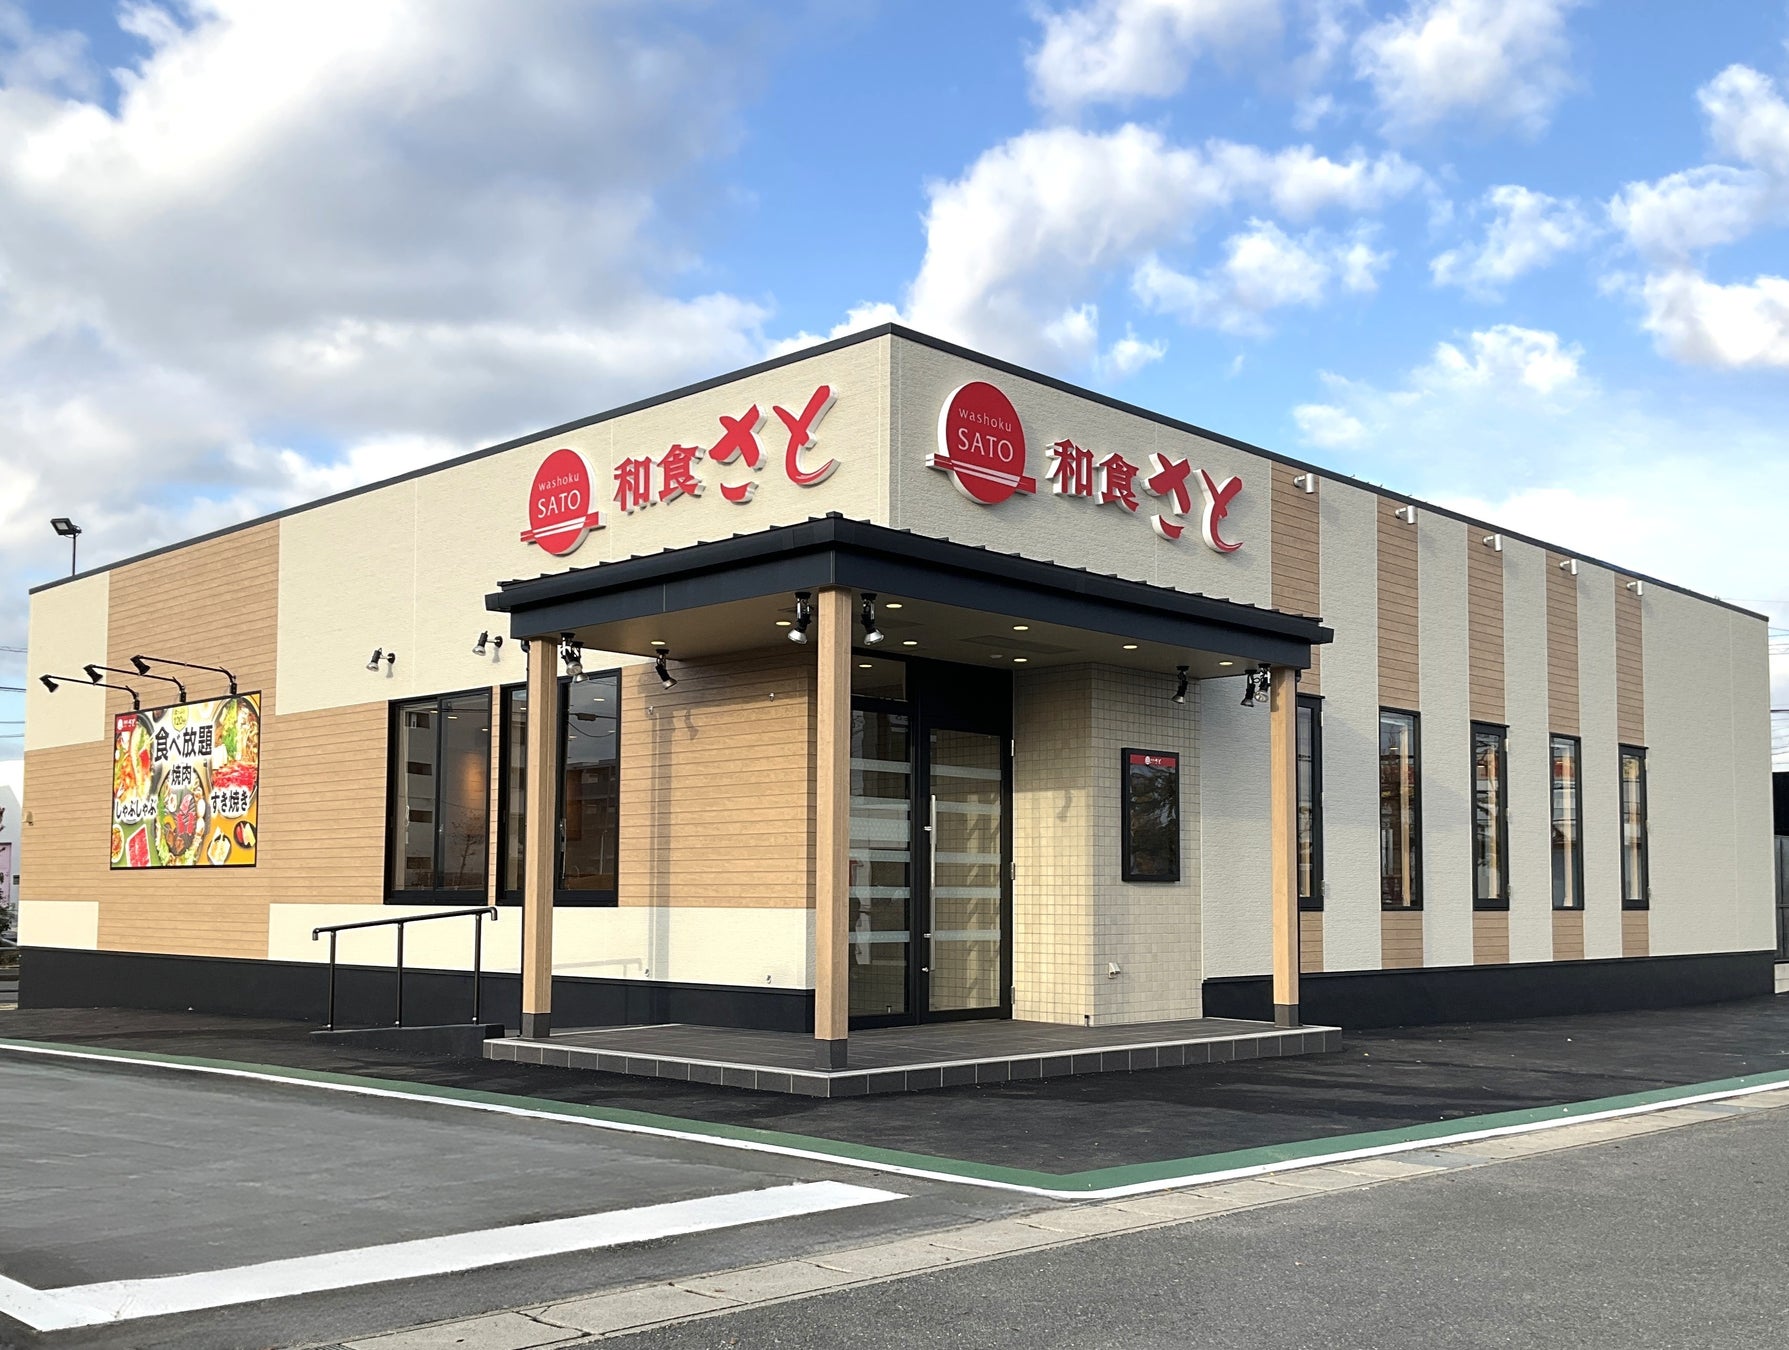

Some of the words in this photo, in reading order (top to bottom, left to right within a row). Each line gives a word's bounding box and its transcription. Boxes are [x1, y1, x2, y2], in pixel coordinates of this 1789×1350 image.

[957, 407, 1012, 433] washoku
[613, 385, 838, 512] 和食さと
[957, 428, 1014, 463] SATO
[538, 472, 580, 490] washoku
[1049, 438, 1244, 552] 和食さと
[537, 489, 581, 519] SATO
[155, 725, 213, 762] 食べ放題
[171, 764, 192, 786] 焼肉
[116, 799, 157, 819] しゃぶしゃぶ
[211, 790, 248, 814] すき焼き
